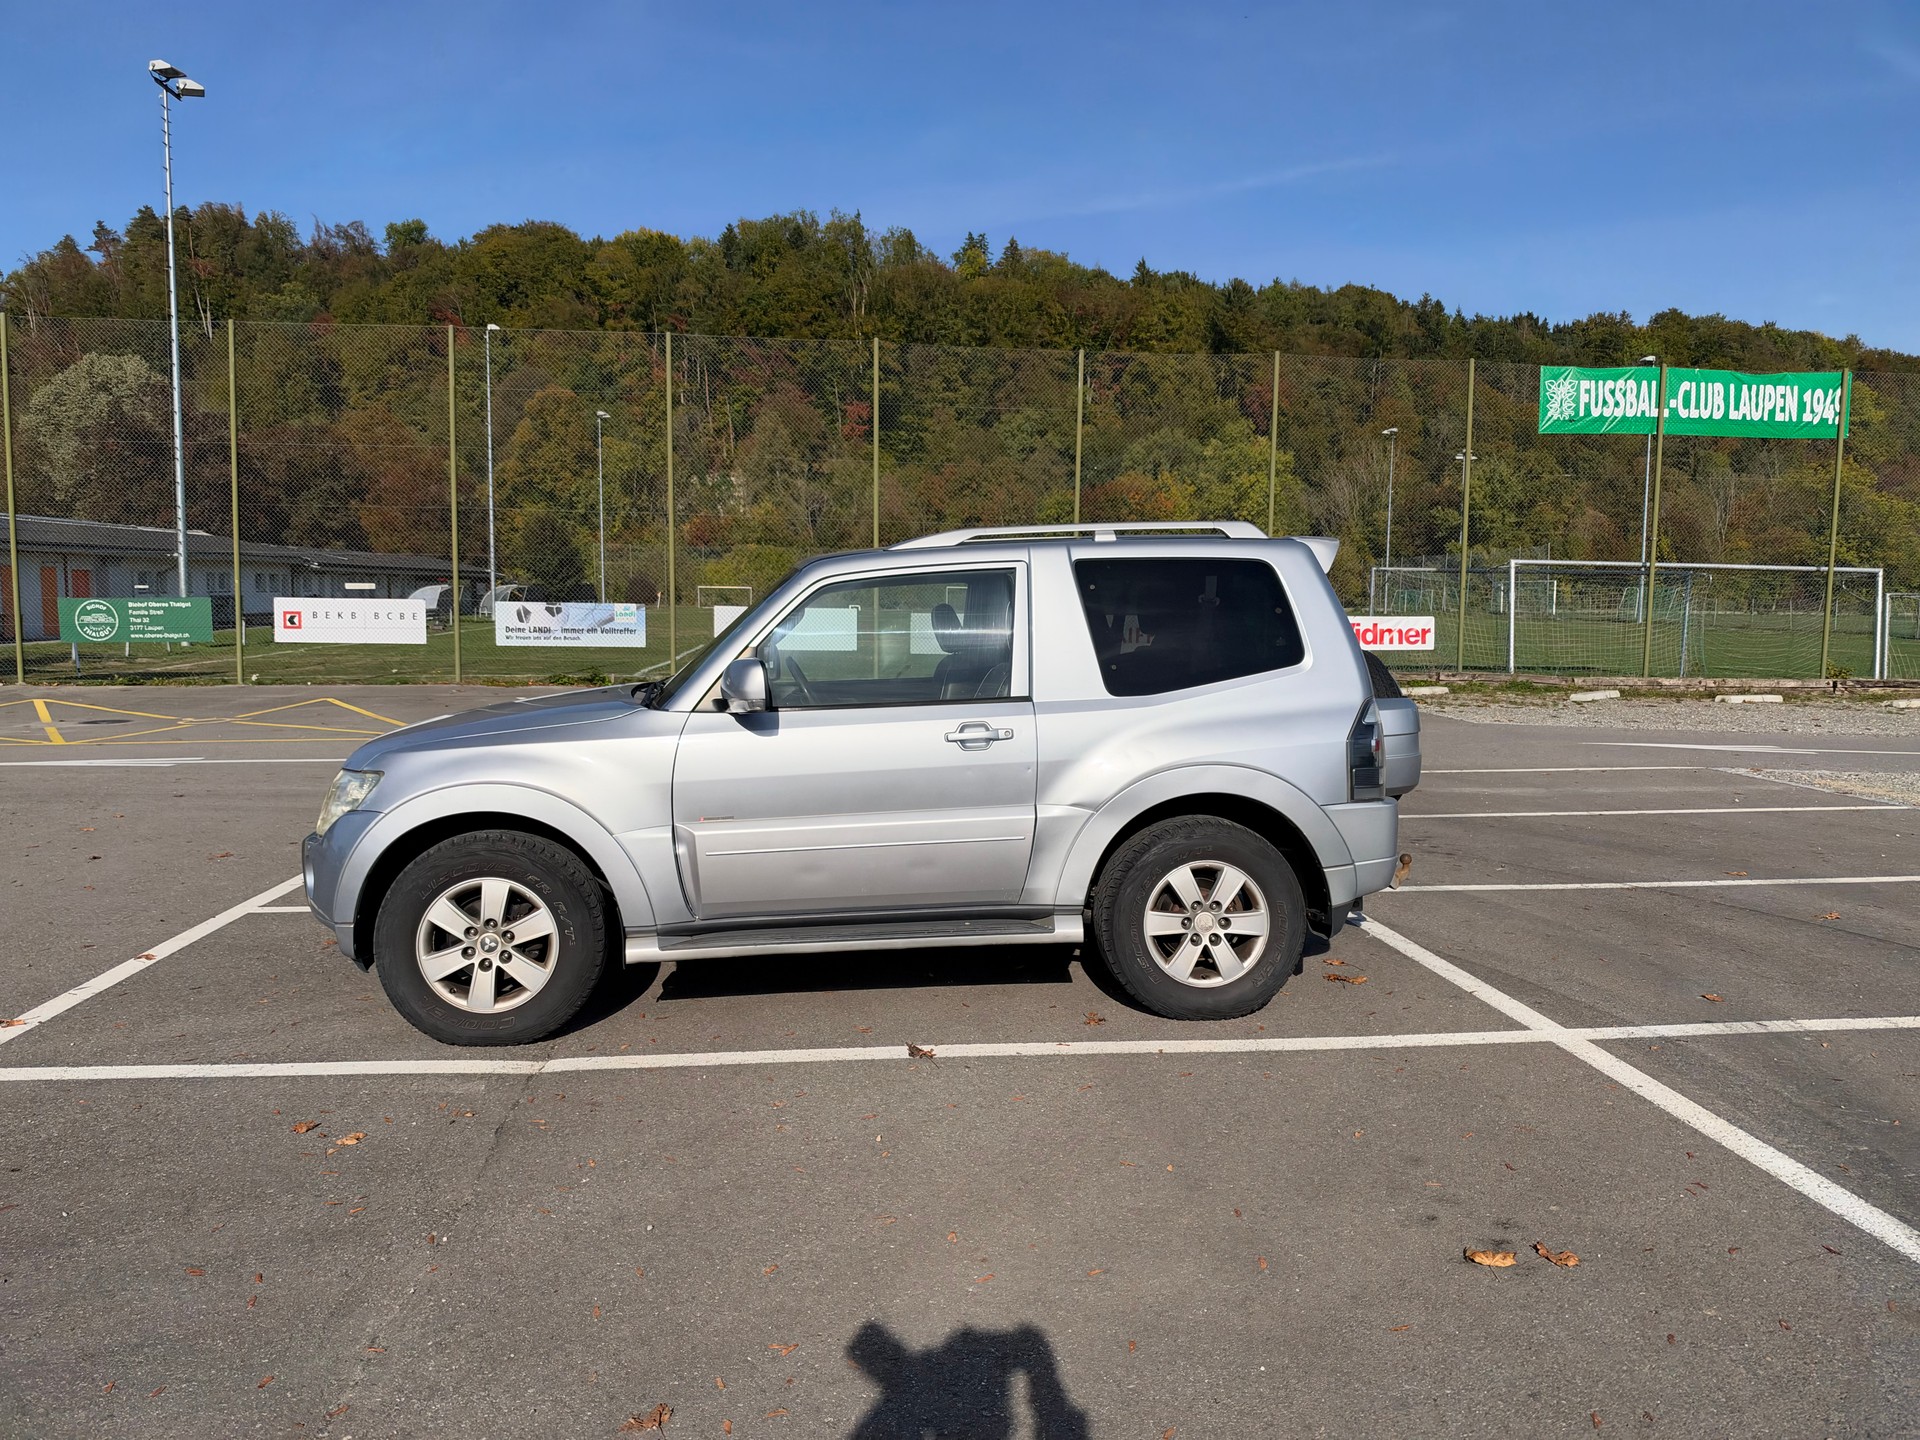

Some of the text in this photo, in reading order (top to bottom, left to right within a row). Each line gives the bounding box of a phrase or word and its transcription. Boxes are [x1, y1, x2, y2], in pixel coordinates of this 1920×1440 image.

[1729, 383, 1798, 422] LAUPEN
[312, 611, 418, 620] BEKB BCBE
[83, 626, 113, 637] THALGUT
[505, 625, 527, 634] Deine
[528, 626, 551, 634] LANDI
[560, 626, 584, 634] immer
[600, 626, 637, 635] Volltreffer
[1350, 623, 1431, 645] idmer
